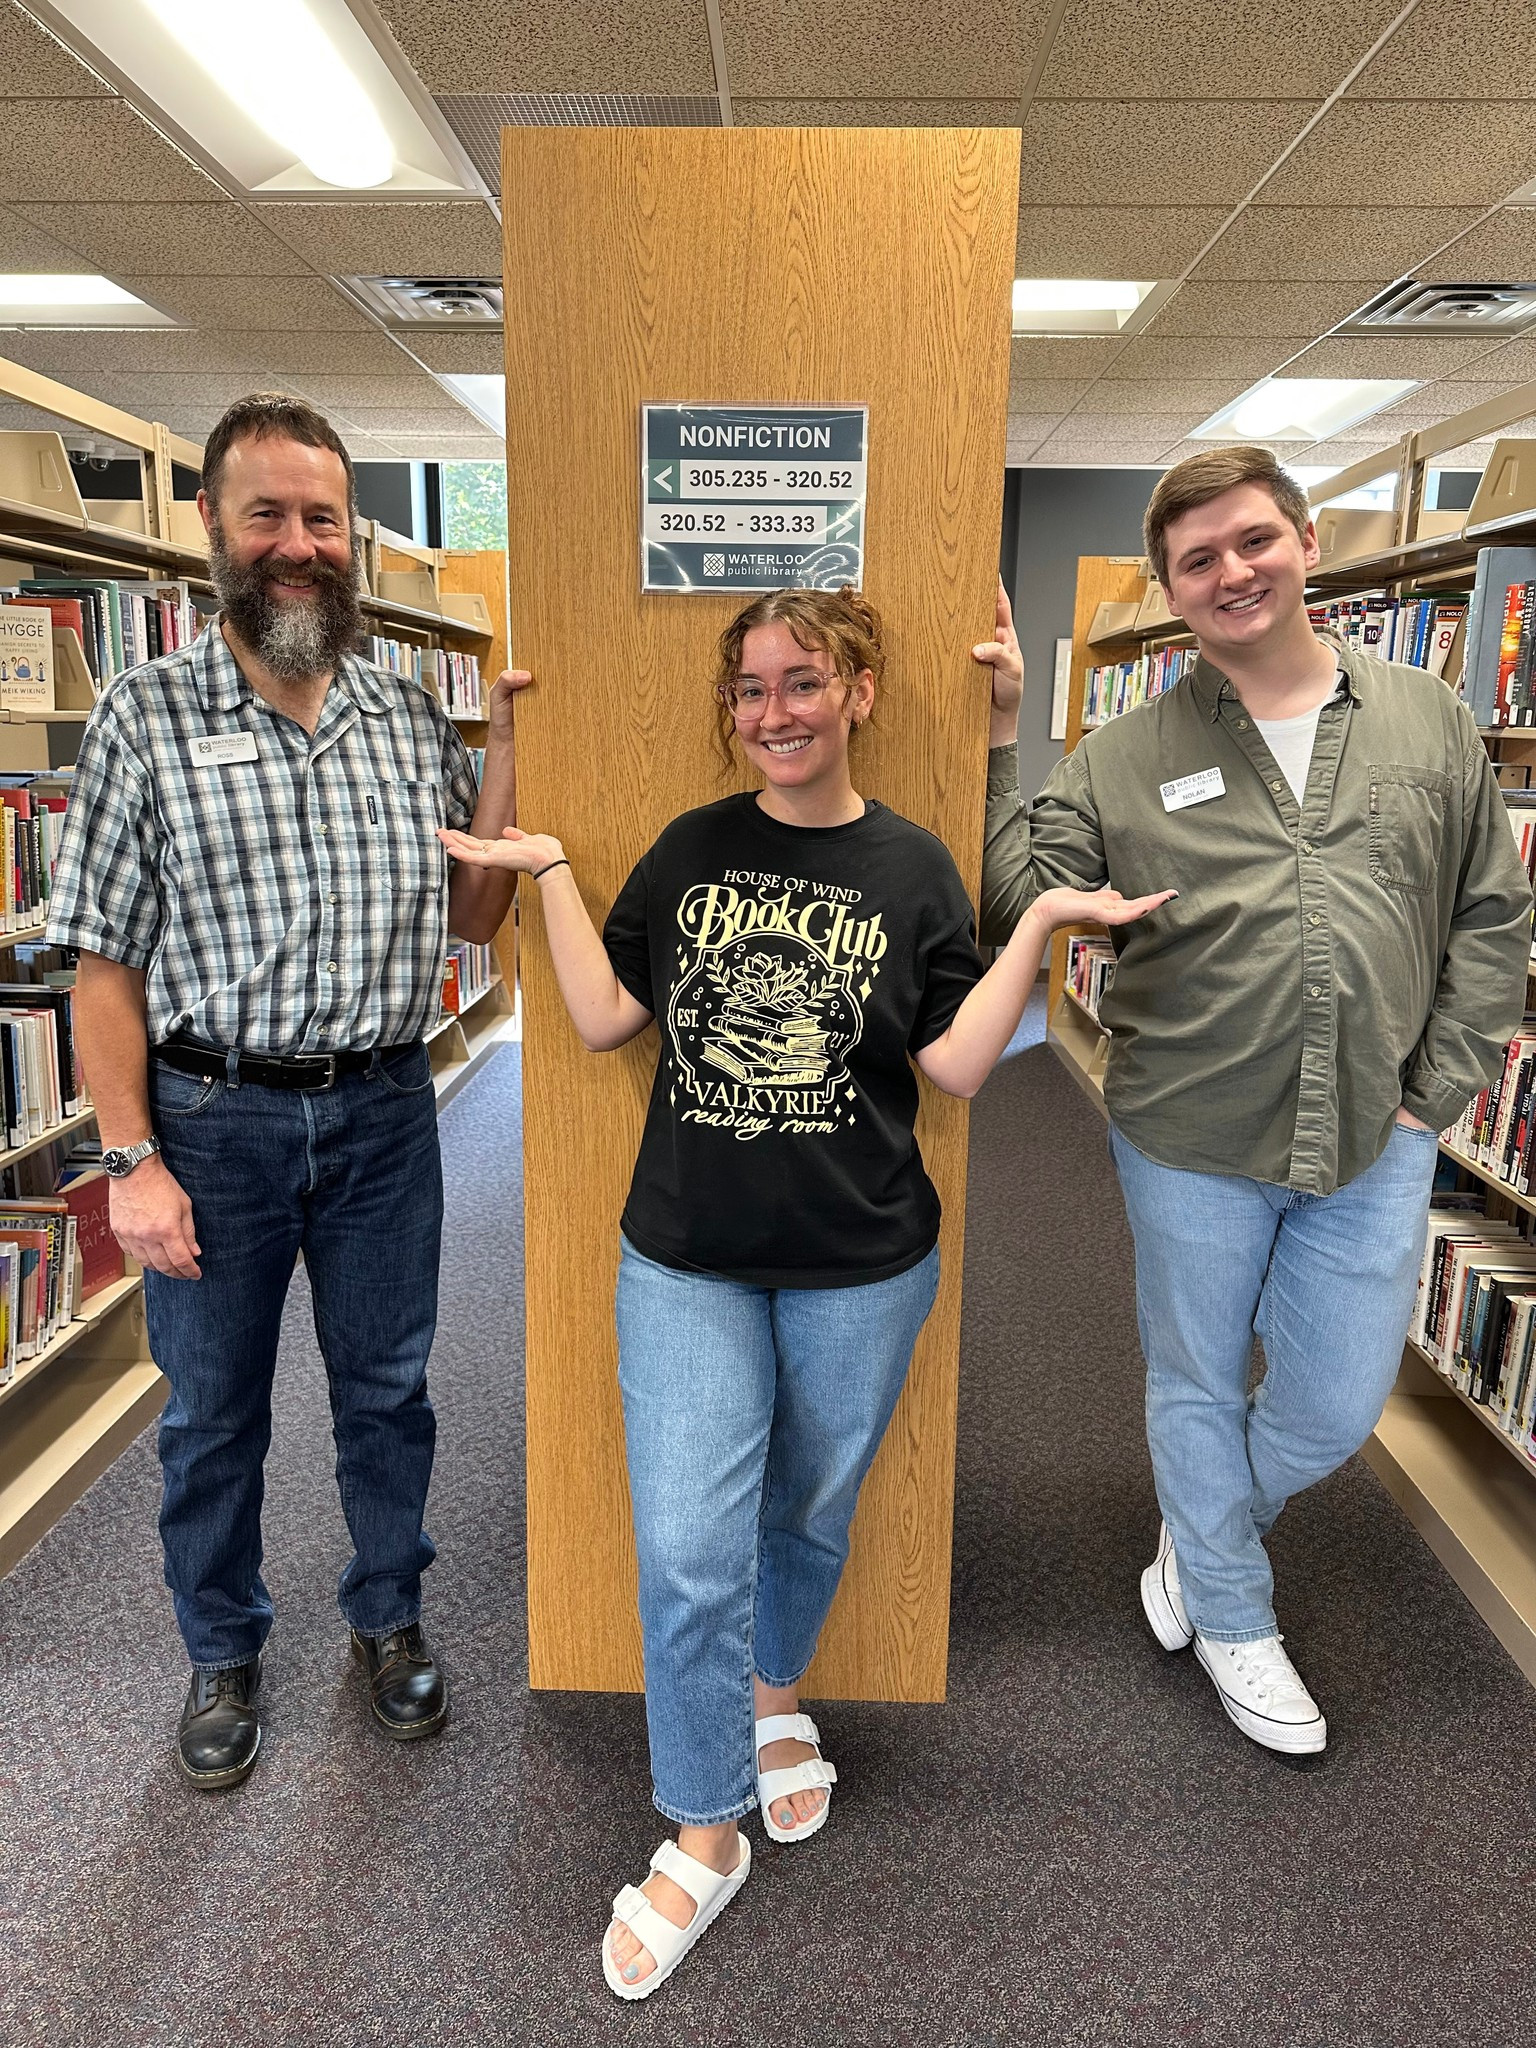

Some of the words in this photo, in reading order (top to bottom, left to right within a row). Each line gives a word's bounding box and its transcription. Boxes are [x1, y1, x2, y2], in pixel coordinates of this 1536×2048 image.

[679, 425, 831, 448] NONFICTION
[689, 469, 767, 488] 305.235
[786, 470, 853, 488] 320.52
[660, 513, 726, 532] 320.52
[749, 515, 816, 533] 333.33
[728, 554, 804, 565] WATERLOO
[727, 566, 761, 577] public
[764, 567, 803, 578] library
[1522, 586, 1535, 634] ACCESSORY
[1367, 630, 1377, 640] 10
[1438, 630, 1452, 649] 8
[211, 737, 247, 745] WATERLOO
[1176, 769, 1219, 787] WATERLOO
[1197, 776, 1220, 786] library
[1182, 788, 1206, 801] NOLAN
[723, 869, 781, 889] HOUSE
[783, 877, 809, 893] OF
[811, 881, 862, 903] WIND
[676, 884, 800, 950] Book
[798, 899, 888, 972] Club
[677, 1008, 699, 1028] EST.
[693, 1081, 825, 1115] VALKYRIE
[1467, 1099, 1476, 1125] DAVID
[681, 1107, 774, 1141] reading
[779, 1118, 839, 1134] room
[80, 1203, 109, 1231] BAD
[46, 1224, 54, 1261] CULTS
[51, 1216, 62, 1279] CAPTIVE
[1432, 1285, 1440, 1312] Anthony
[1447, 1281, 1455, 1311] UNDERCLASS
[1470, 1279, 1478, 1300] WHEN
[1466, 1310, 1474, 1327] GETS
